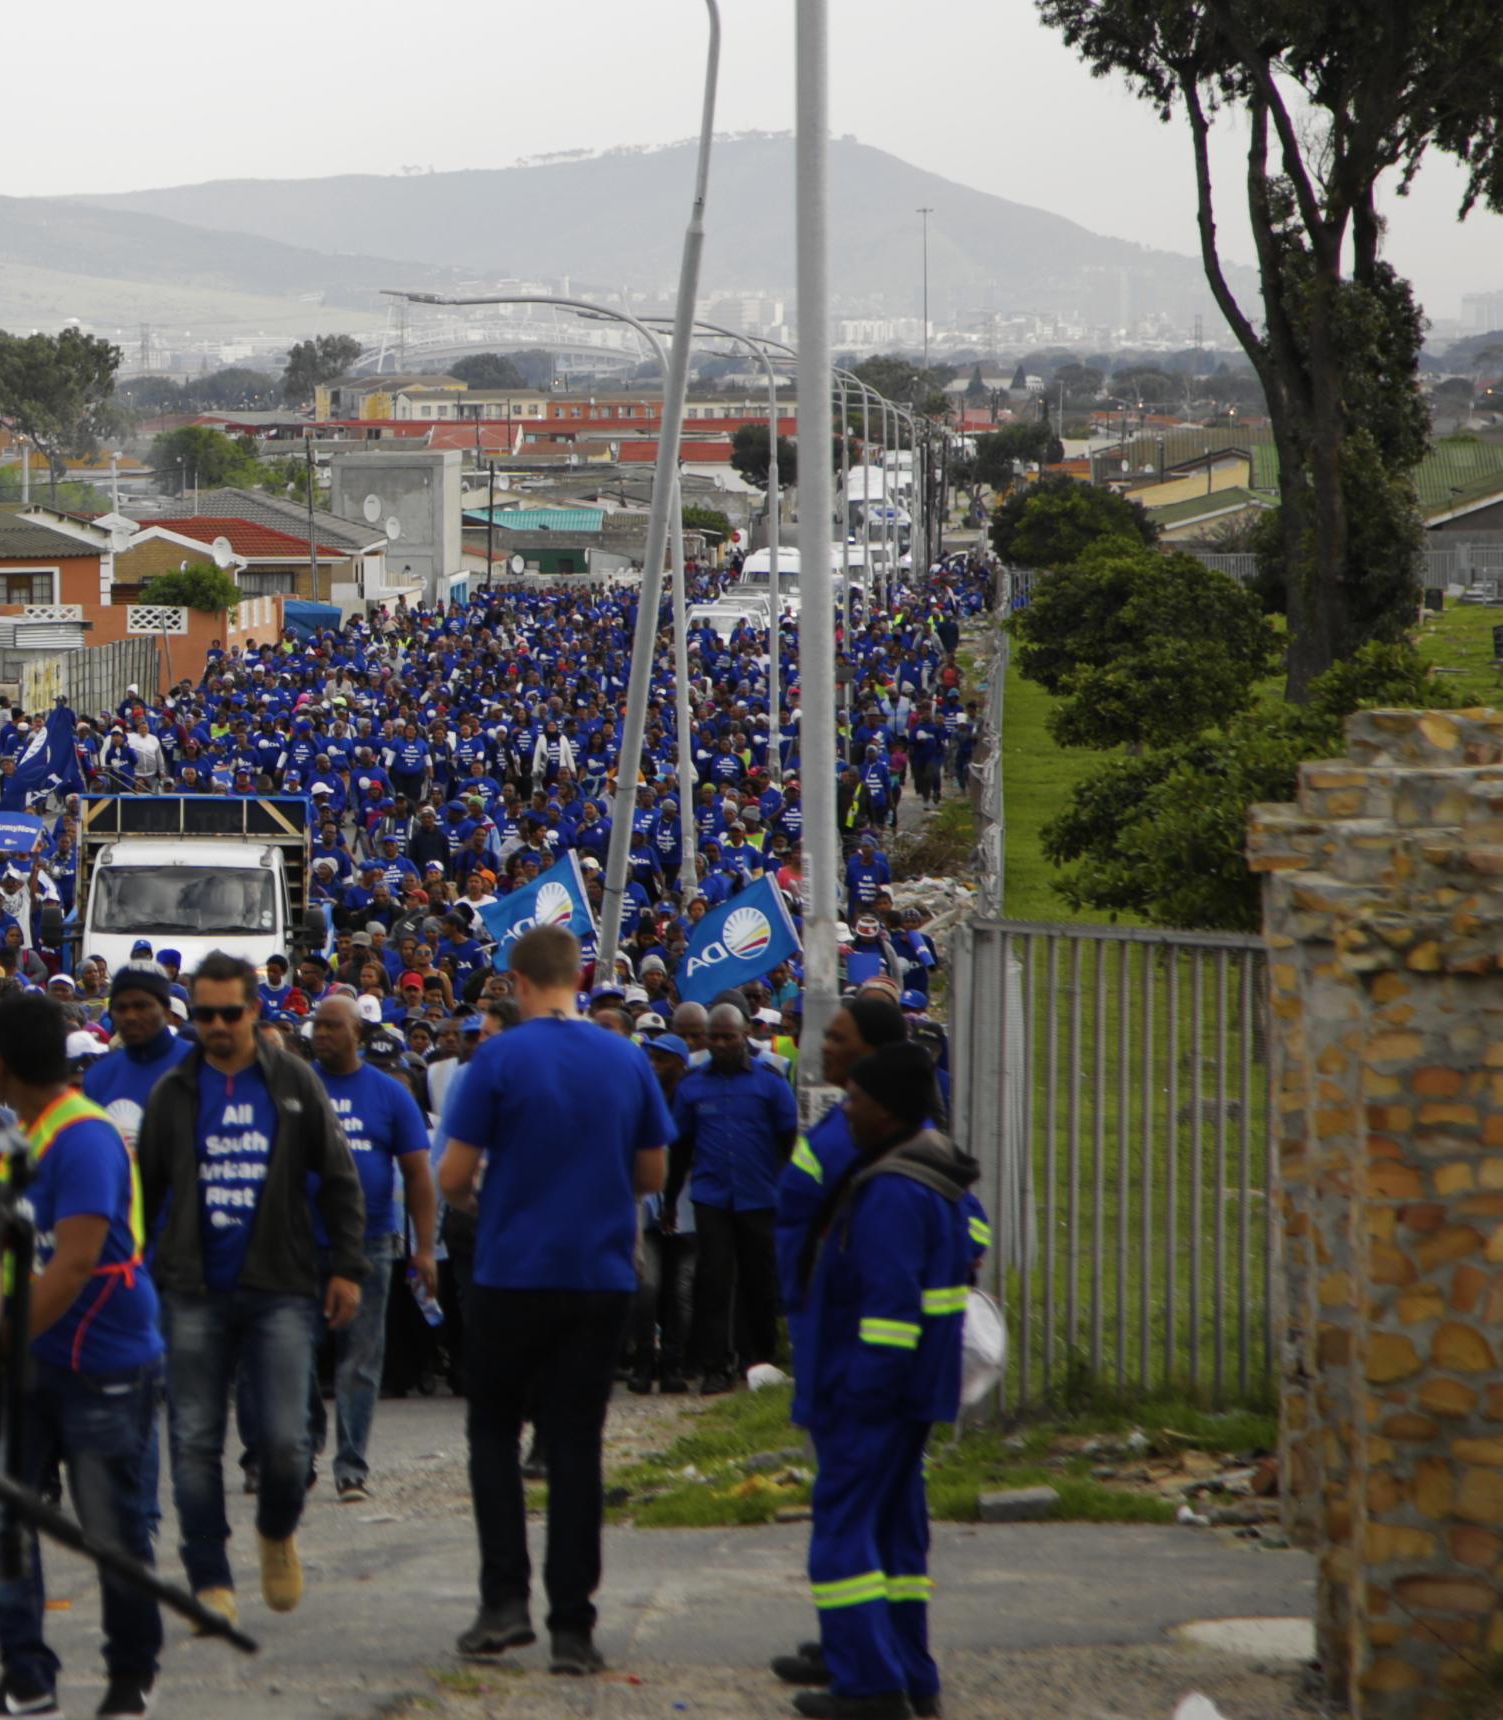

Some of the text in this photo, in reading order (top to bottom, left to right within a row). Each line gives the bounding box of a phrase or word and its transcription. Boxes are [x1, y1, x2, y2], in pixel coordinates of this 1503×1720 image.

[222, 1103, 254, 1126] All
[205, 1131, 269, 1155] South
[199, 1160, 268, 1181] African
[205, 1186, 255, 1208] First
